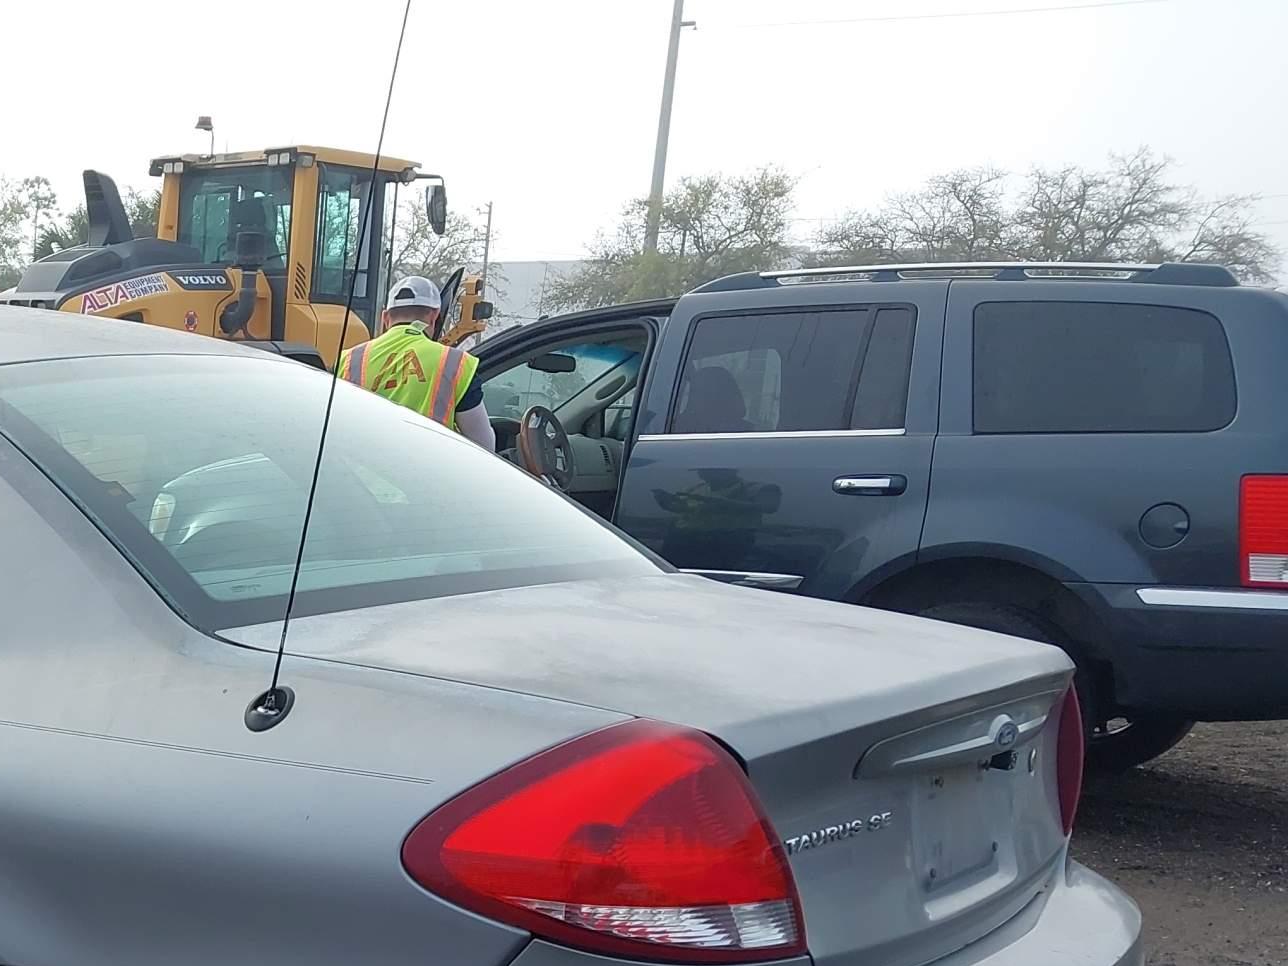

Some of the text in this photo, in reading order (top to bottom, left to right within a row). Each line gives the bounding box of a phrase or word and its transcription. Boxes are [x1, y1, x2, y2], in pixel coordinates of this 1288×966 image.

[124, 275, 164, 290] EQUIPMENT
[176, 275, 227, 286] VOLVO
[81, 284, 130, 314] ALTA
[128, 283, 168, 299] COMPANY
[784, 819, 862, 854] TAURUS
